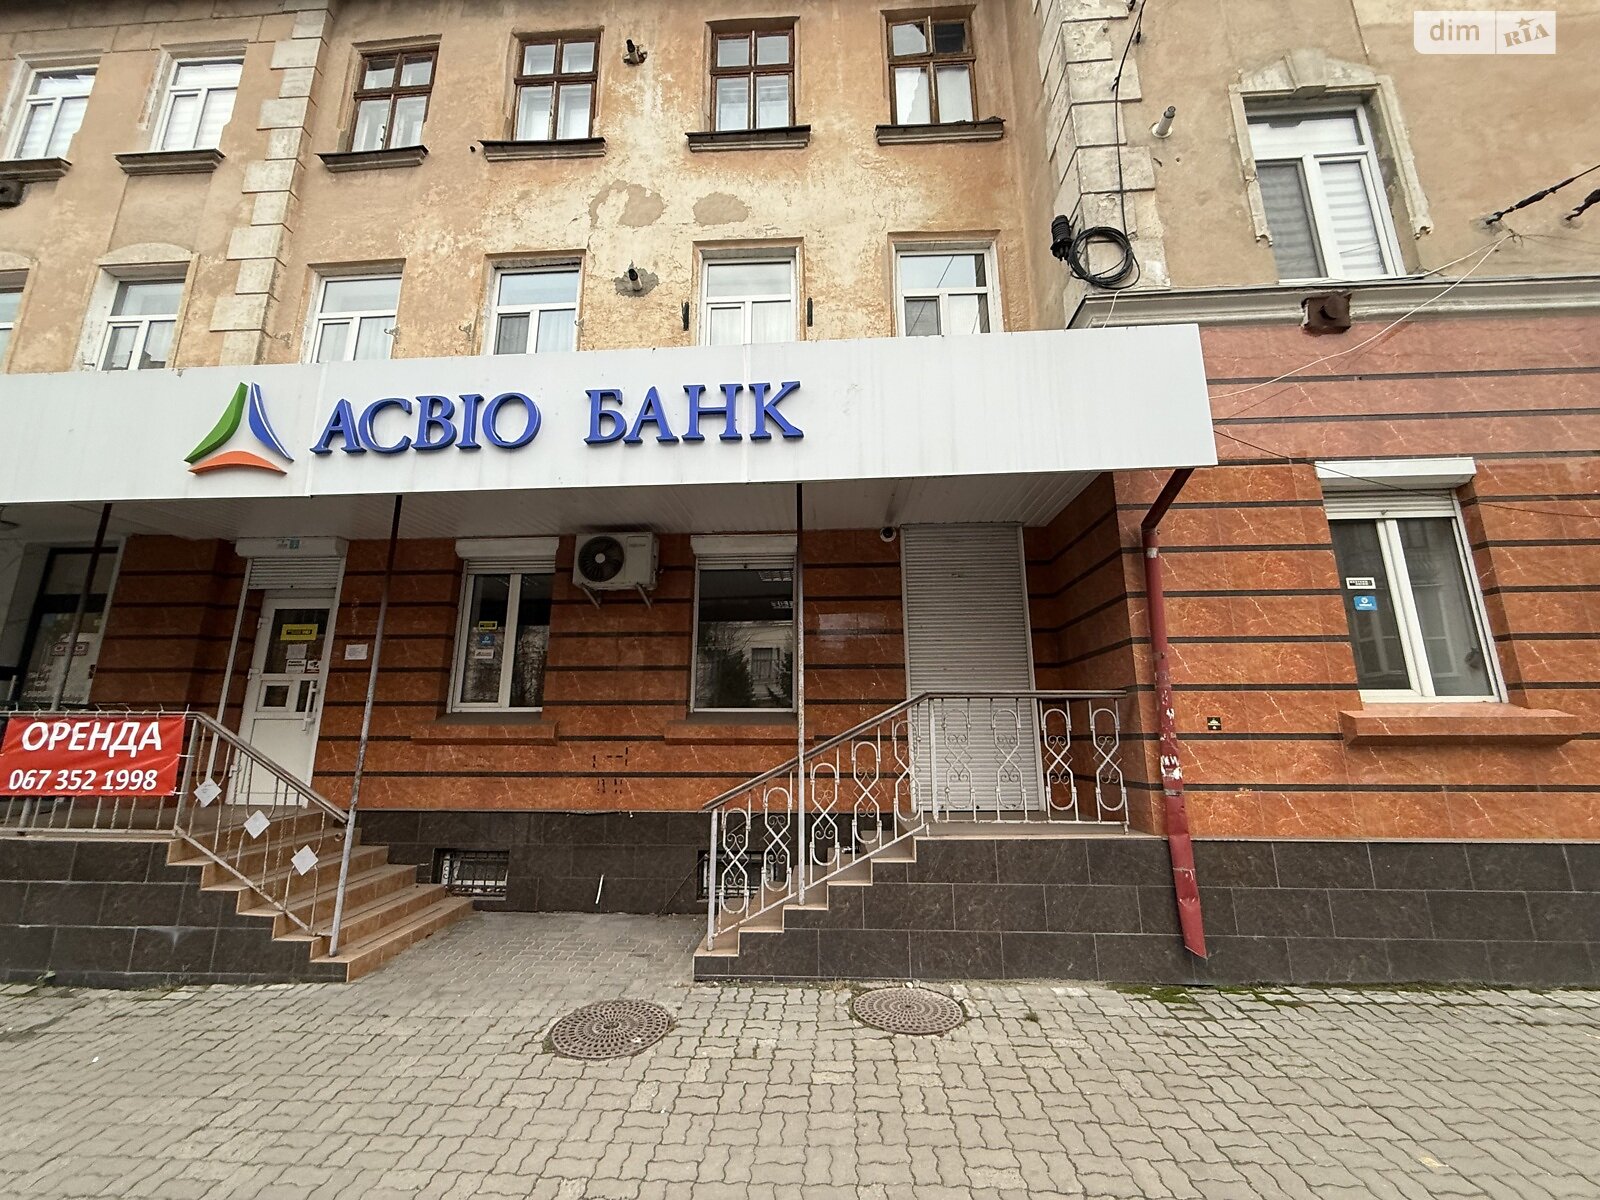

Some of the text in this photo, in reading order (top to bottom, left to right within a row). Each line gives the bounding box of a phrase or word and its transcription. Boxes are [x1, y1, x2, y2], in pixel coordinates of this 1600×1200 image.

[309, 380, 805, 454] АСВІО БАНК
[22, 721, 162, 758] ОРЕНДА
[8, 769, 158, 791] 067 352 1998
